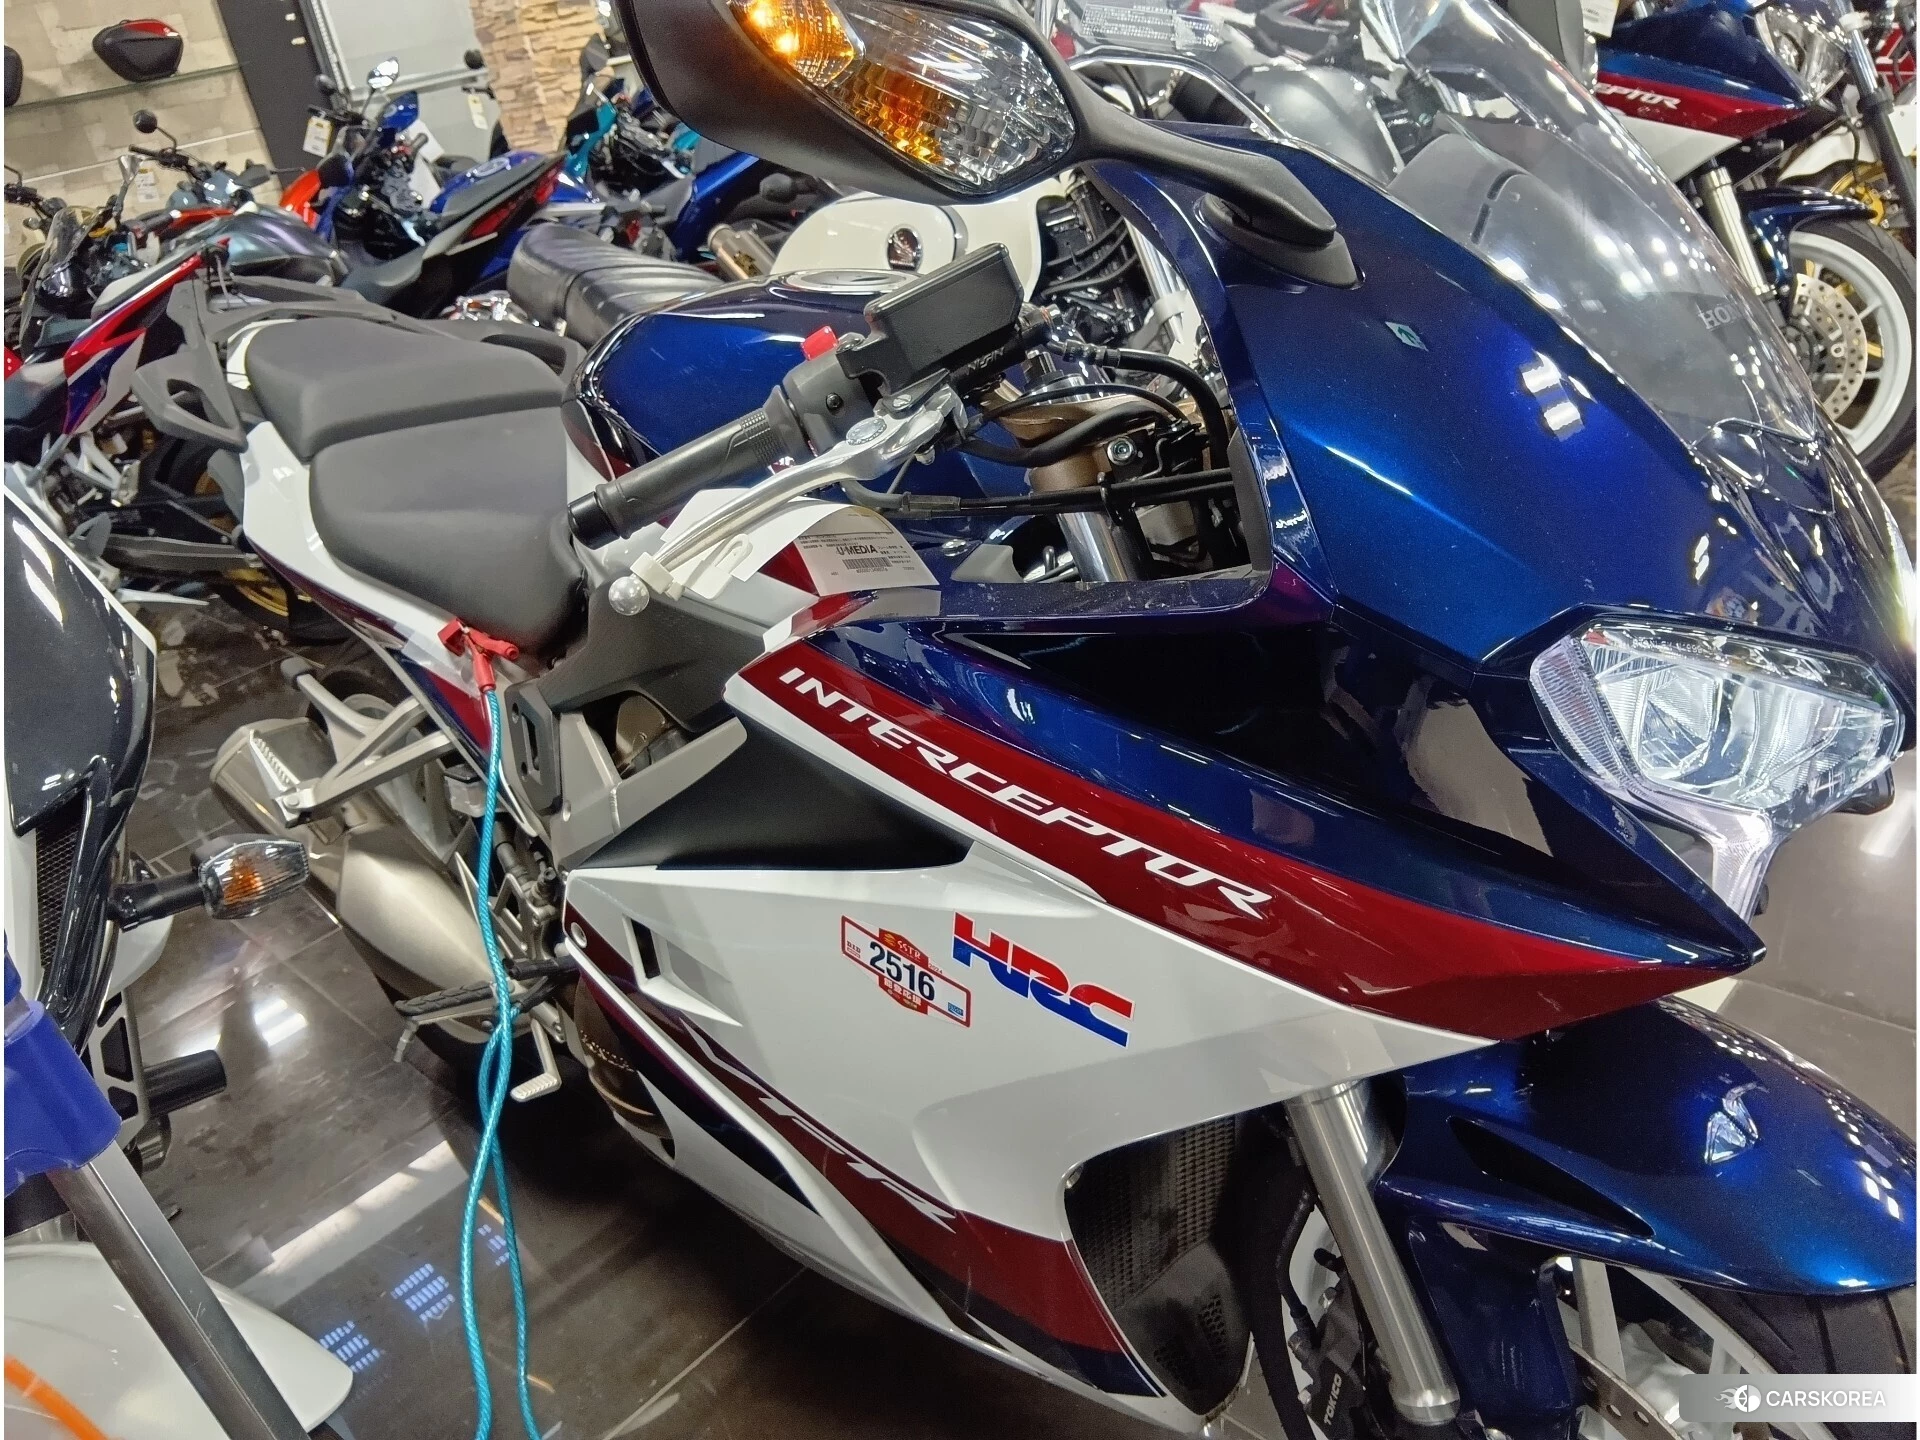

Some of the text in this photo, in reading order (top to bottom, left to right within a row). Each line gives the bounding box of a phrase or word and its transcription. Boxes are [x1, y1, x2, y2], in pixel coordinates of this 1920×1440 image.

[779, 667, 1272, 919] INTERCEPTOR
[869, 940, 935, 1002] 2516
[897, 940, 922, 960] SSTR
[953, 911, 1136, 1049] HRC
[1323, 1373, 1342, 1426] TOKICO
